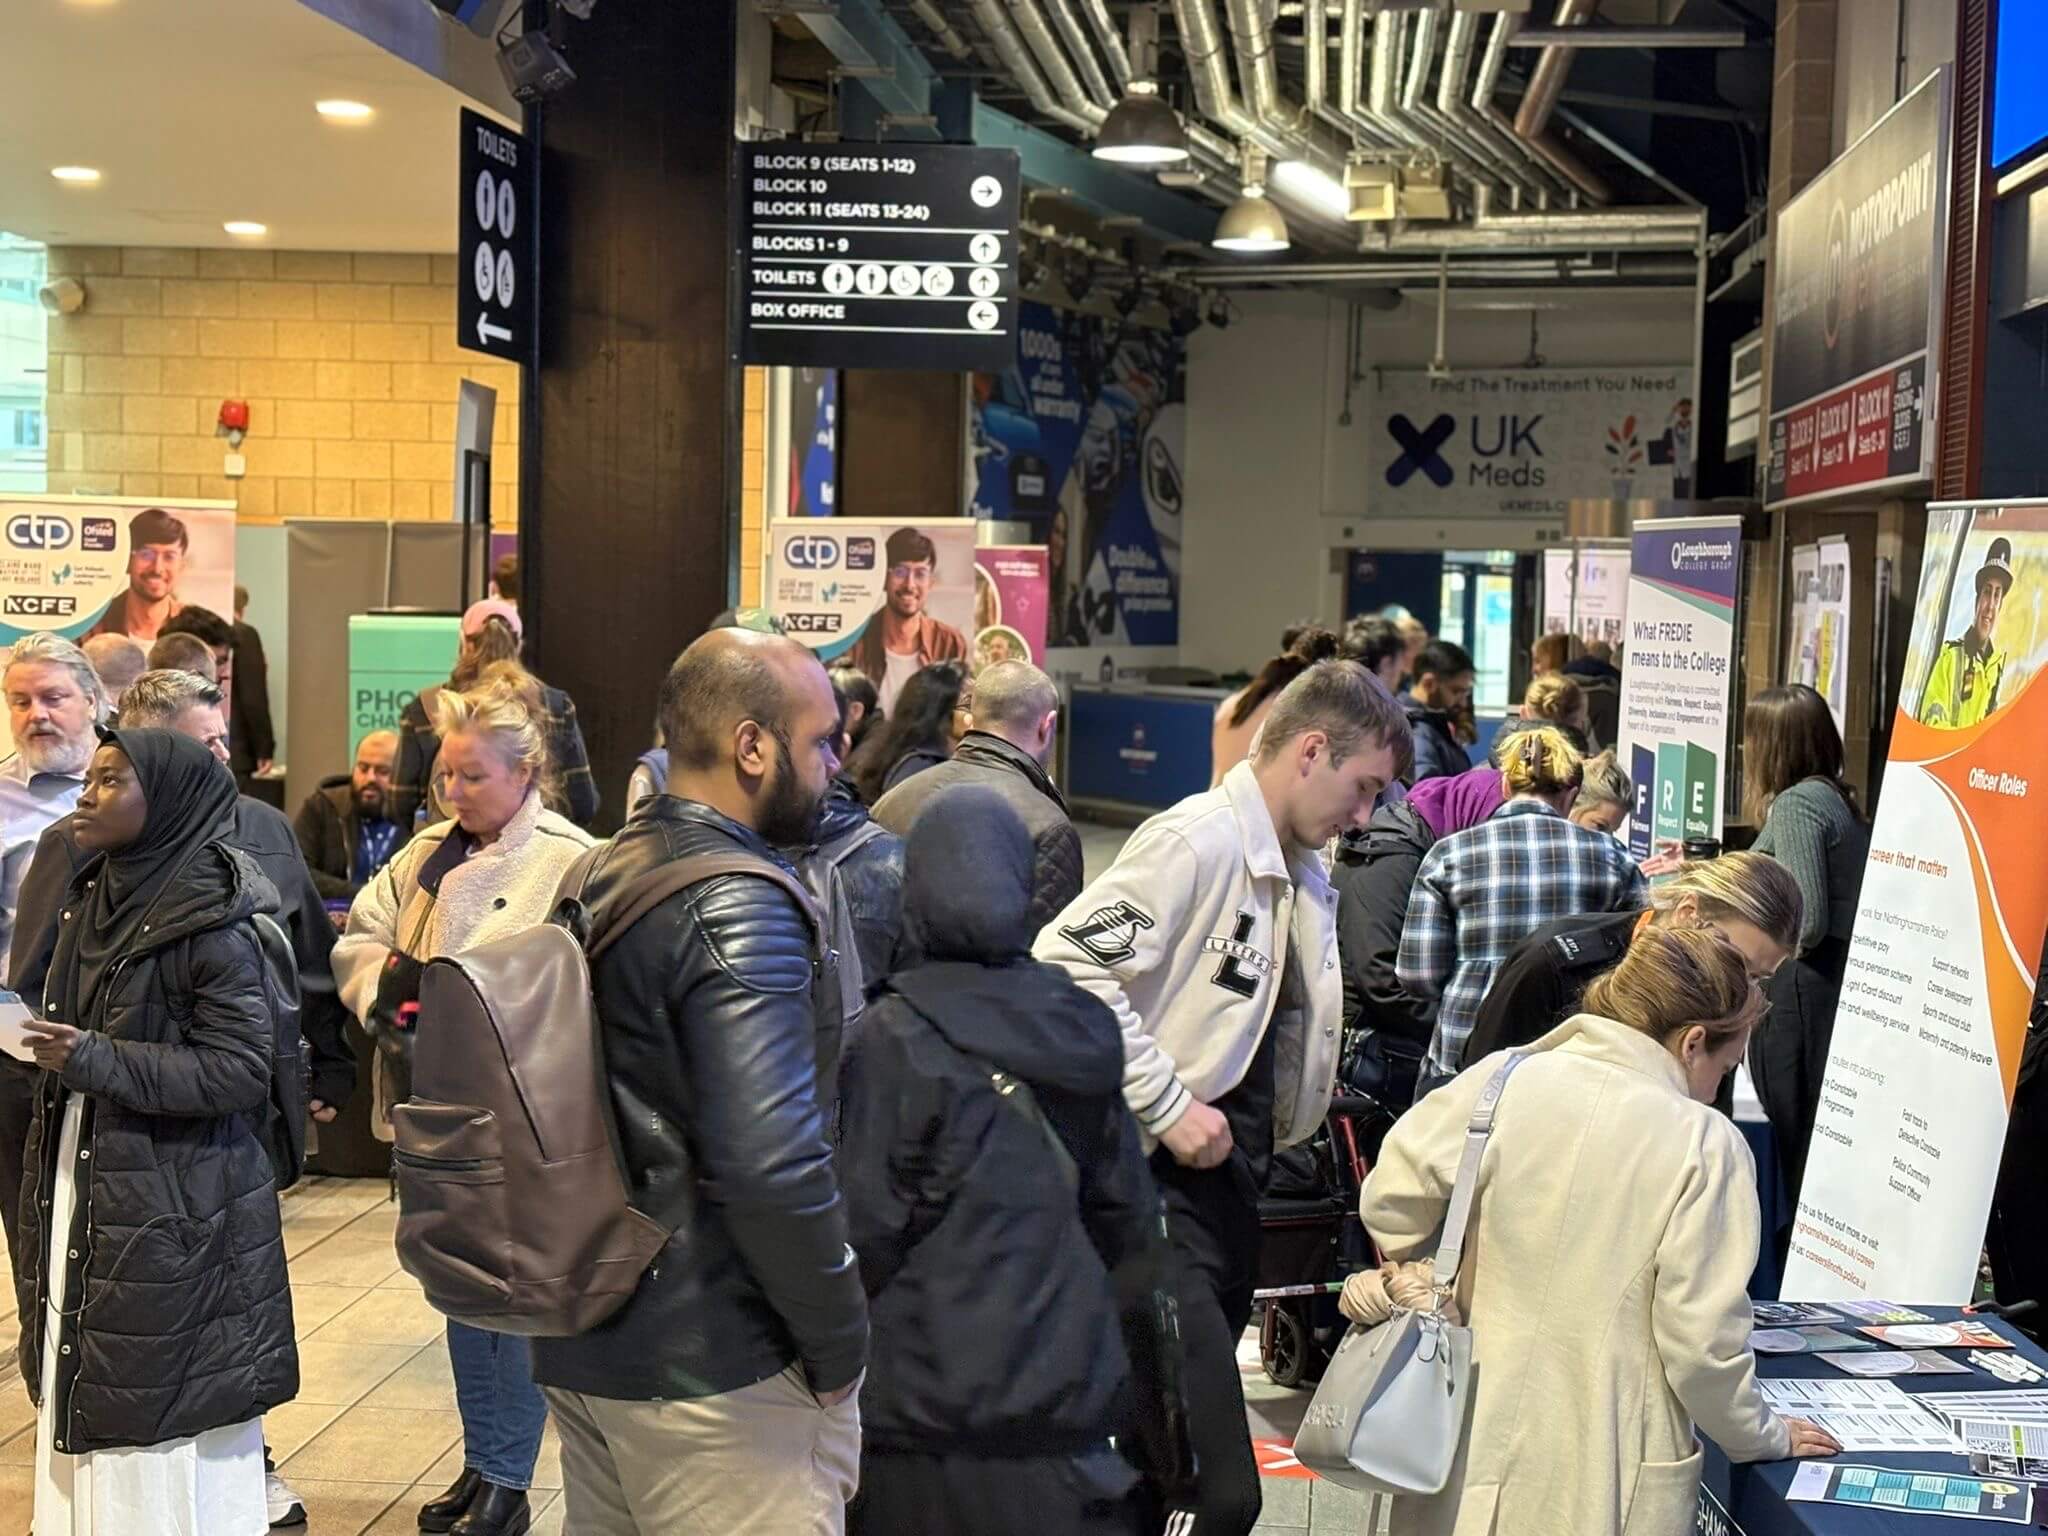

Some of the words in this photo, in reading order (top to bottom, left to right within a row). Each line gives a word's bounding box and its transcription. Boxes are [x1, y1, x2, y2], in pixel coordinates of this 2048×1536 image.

[476, 126, 517, 167] TOILETS
[753, 156, 806, 169] BLOCK
[810, 157, 821, 169] 9
[824, 157, 879, 172] (SEATS
[882, 159, 916, 174] 1-12)
[753, 179, 806, 192] BLOCK
[810, 180, 828, 194] 10
[753, 202, 806, 215] BLOCK
[810, 203, 822, 216] 11
[824, 204, 880, 218] (SEATS
[883, 205, 930, 221] 13-24)
[1851, 151, 1931, 257] MOTORPOINT
[753, 237, 815, 250] BLOCKS
[817, 238, 824, 251] 1
[838, 238, 849, 251] 9
[752, 270, 816, 284] TOILETS
[751, 304, 784, 317] BOX
[788, 304, 845, 319] OFFICE
[1431, 378, 1465, 393] Find
[1471, 378, 1499, 392] The
[1504, 378, 1590, 393] Treatment
[1595, 378, 1625, 392] You
[1631, 377, 1676, 391] Need
[1858, 387, 1882, 427] BLOCK
[1820, 404, 1841, 440] BLOCK
[1471, 415, 1543, 457] UK
[1469, 461, 1545, 487] Meds
[1681, 541, 1732, 560] Loughborough
[6, 598, 73, 614] NCFE
[1633, 621, 1657, 640] What
[1659, 622, 1693, 642] FREDIE
[1631, 651, 1660, 668] means
[1662, 650, 1671, 669] to
[1673, 650, 1688, 670] the
[1690, 651, 1726, 676] College
[1969, 767, 1997, 792] Officer
[1999, 772, 2028, 797] Roles
[1636, 784, 1647, 815] F
[1662, 780, 1674, 812] R
[1692, 781, 1704, 814] E
[1686, 818, 1708, 835] Equality
[1895, 851, 1917, 870] that
[1917, 857, 1949, 878] matters
[1874, 908, 1883, 921] for
[1884, 911, 1930, 935] Nottinghamshire
[1205, 937, 1270, 972] LAKERS
[1878, 941, 1890, 955] pay
[1865, 962, 1890, 977] pension
[1890, 969, 1913, 984] scheme
[1931, 956, 1950, 973] Support
[1861, 981, 1878, 997] Card
[1878, 988, 1903, 1006] discount
[1927, 979, 1944, 996] Career
[1847, 1003, 1861, 1016] and
[1861, 1007, 1889, 1028] wellbeing
[1889, 1018, 1910, 1033] service
[1922, 1003, 1938, 1019] Sports
[1970, 1048, 1993, 1067] leave
[1829, 1078, 1858, 1100] Constable
[1824, 1095, 1855, 1118] Programme
[1825, 1126, 1853, 1148] Constable
[1893, 1156, 1907, 1173] Police
[1906, 1163, 1932, 1190] Community
[1888, 1175, 1907, 1194] Support
[1906, 1185, 1922, 1203] Officer
[1823, 1212, 1835, 1228] find
[1834, 1219, 1846, 1233] out
